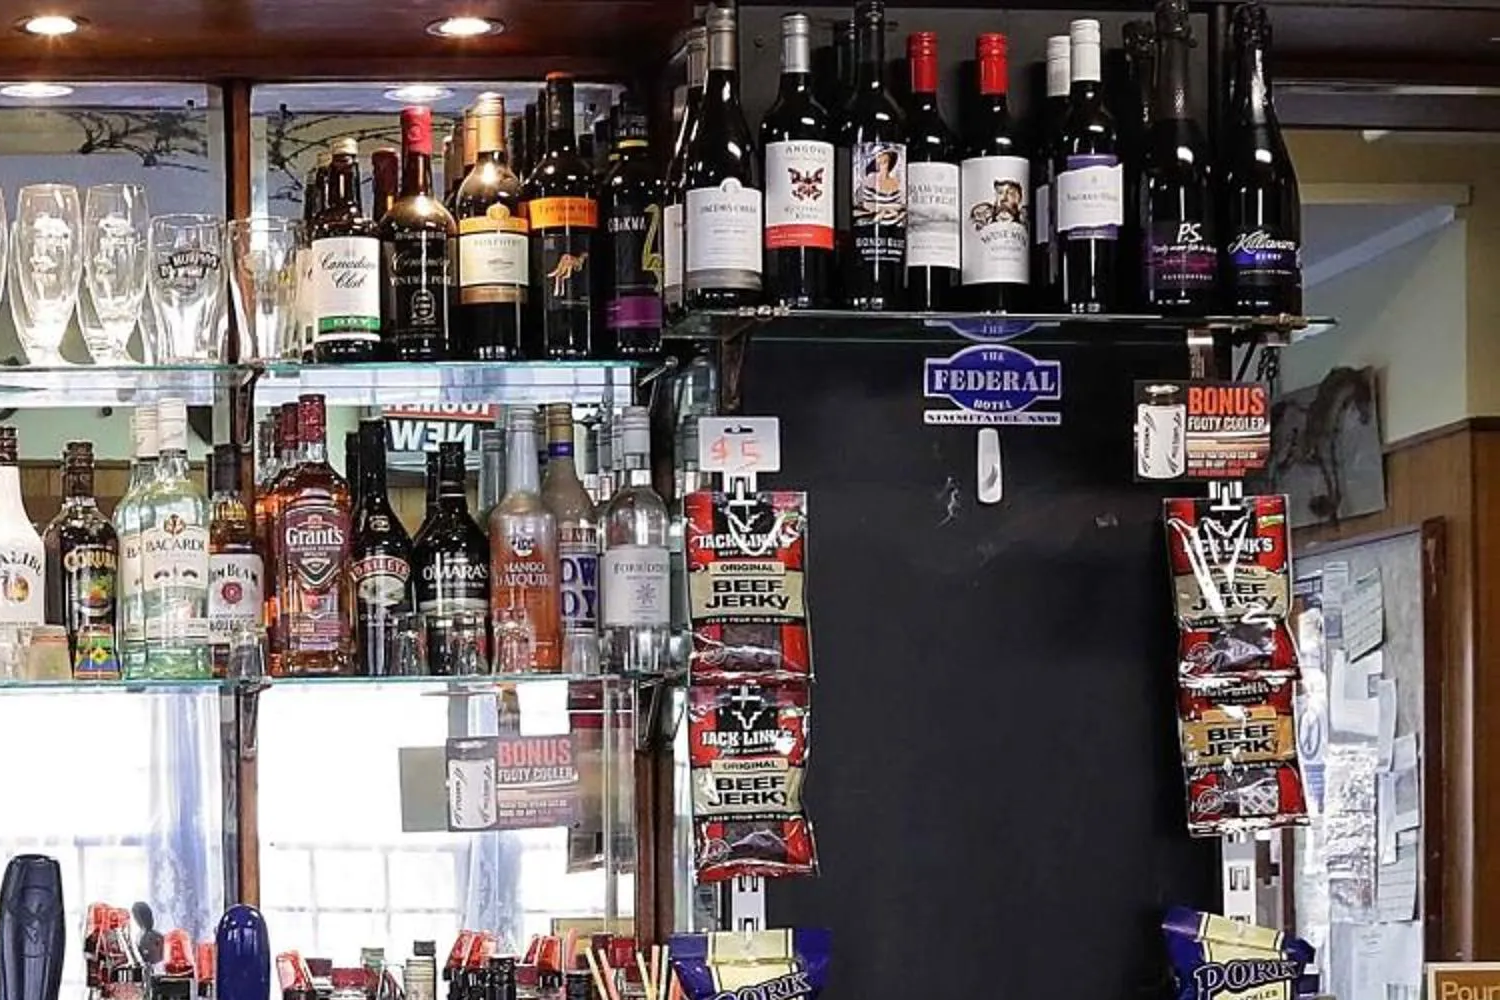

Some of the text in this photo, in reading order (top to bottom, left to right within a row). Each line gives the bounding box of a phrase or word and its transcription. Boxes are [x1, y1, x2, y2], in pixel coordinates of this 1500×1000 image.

[934, 369, 1056, 392] FEDERAL
[1188, 387, 1265, 415] BONUS
[1188, 416, 1222, 432] FOOTY
[713, 579, 785, 594] BEEF
[702, 730, 741, 747] JACK
[498, 739, 572, 767] BONUS
[715, 776, 786, 792] BEEF
